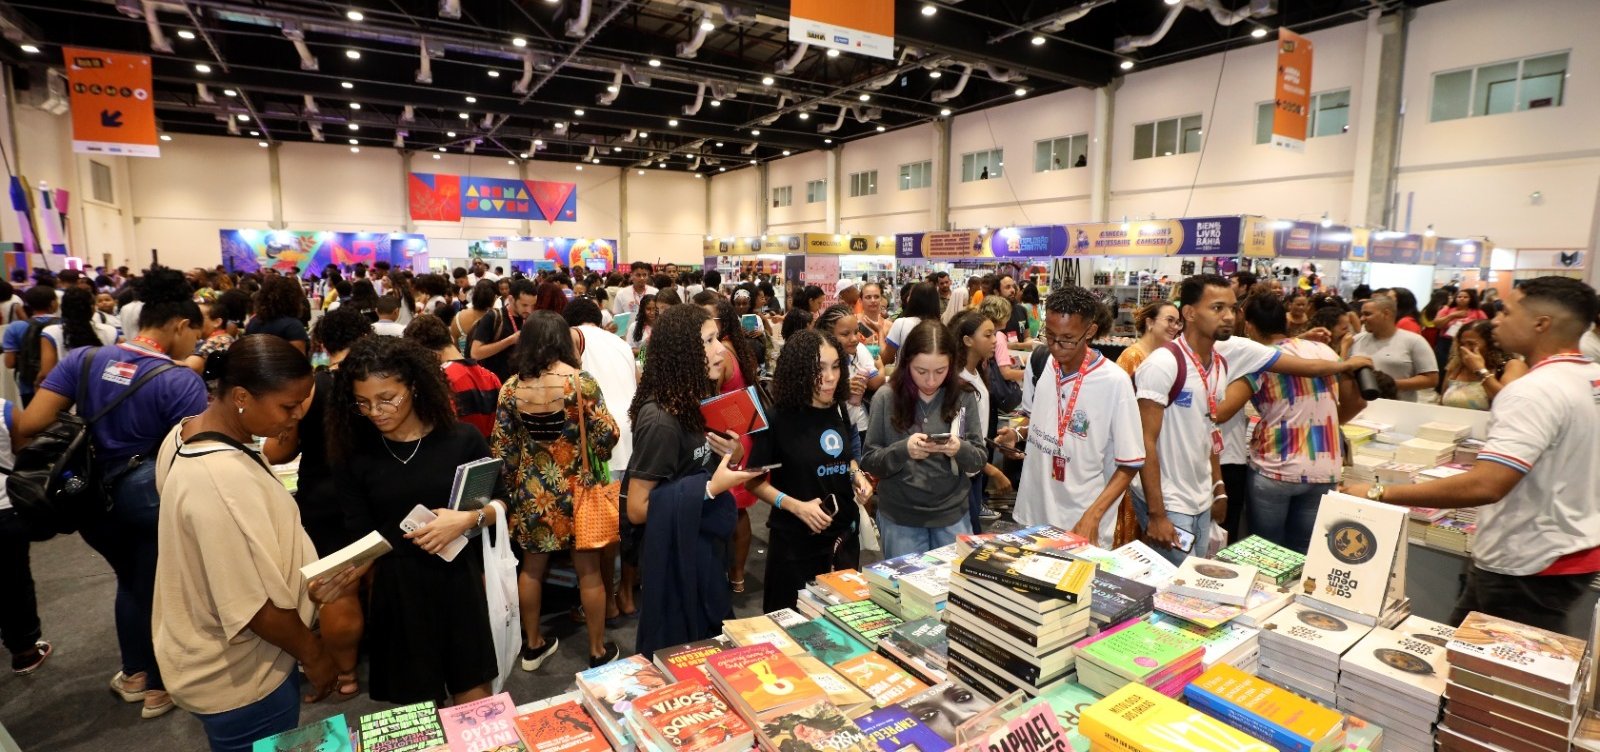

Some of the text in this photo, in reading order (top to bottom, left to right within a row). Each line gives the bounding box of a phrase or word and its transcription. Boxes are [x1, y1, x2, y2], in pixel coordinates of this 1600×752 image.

[853, 241, 864, 250] Alt
[817, 464, 850, 477] Omeg
[1327, 574, 1358, 589] Deus
[1331, 568, 1351, 579] pai
[667, 648, 722, 664] EMPREGADA
[653, 691, 706, 714] SOFIA
[901, 692, 929, 709] VIOLA
[662, 706, 726, 737] MUNDO
[461, 720, 508, 743] SEÇÃO
[467, 730, 512, 752] INTER
[890, 736, 901, 745] A
